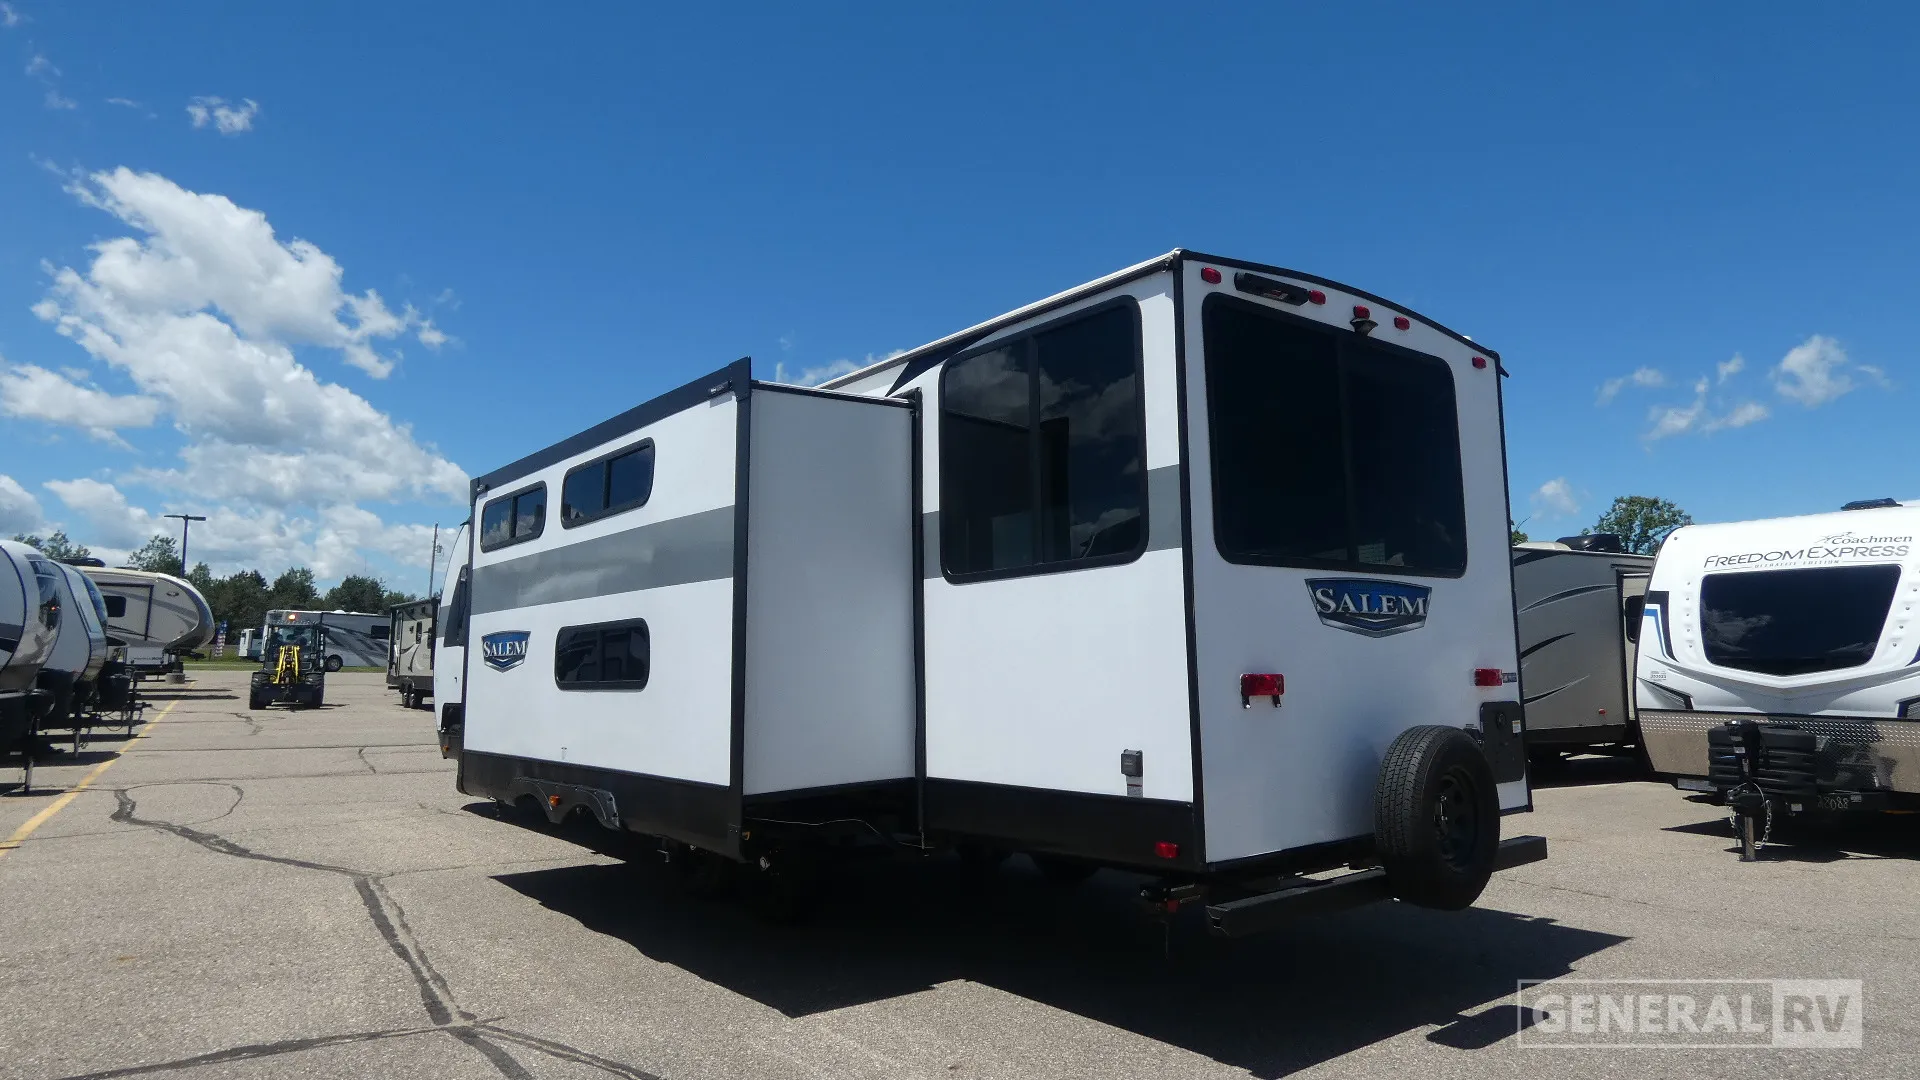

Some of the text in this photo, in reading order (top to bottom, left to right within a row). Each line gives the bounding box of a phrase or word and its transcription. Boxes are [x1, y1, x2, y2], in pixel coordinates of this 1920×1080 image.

[1831, 535, 1913, 545] Coachmen
[1704, 545, 1910, 568] FREEDOM EXPRESS
[1315, 588, 1427, 616] SALEM
[483, 640, 527, 657] SALEM
